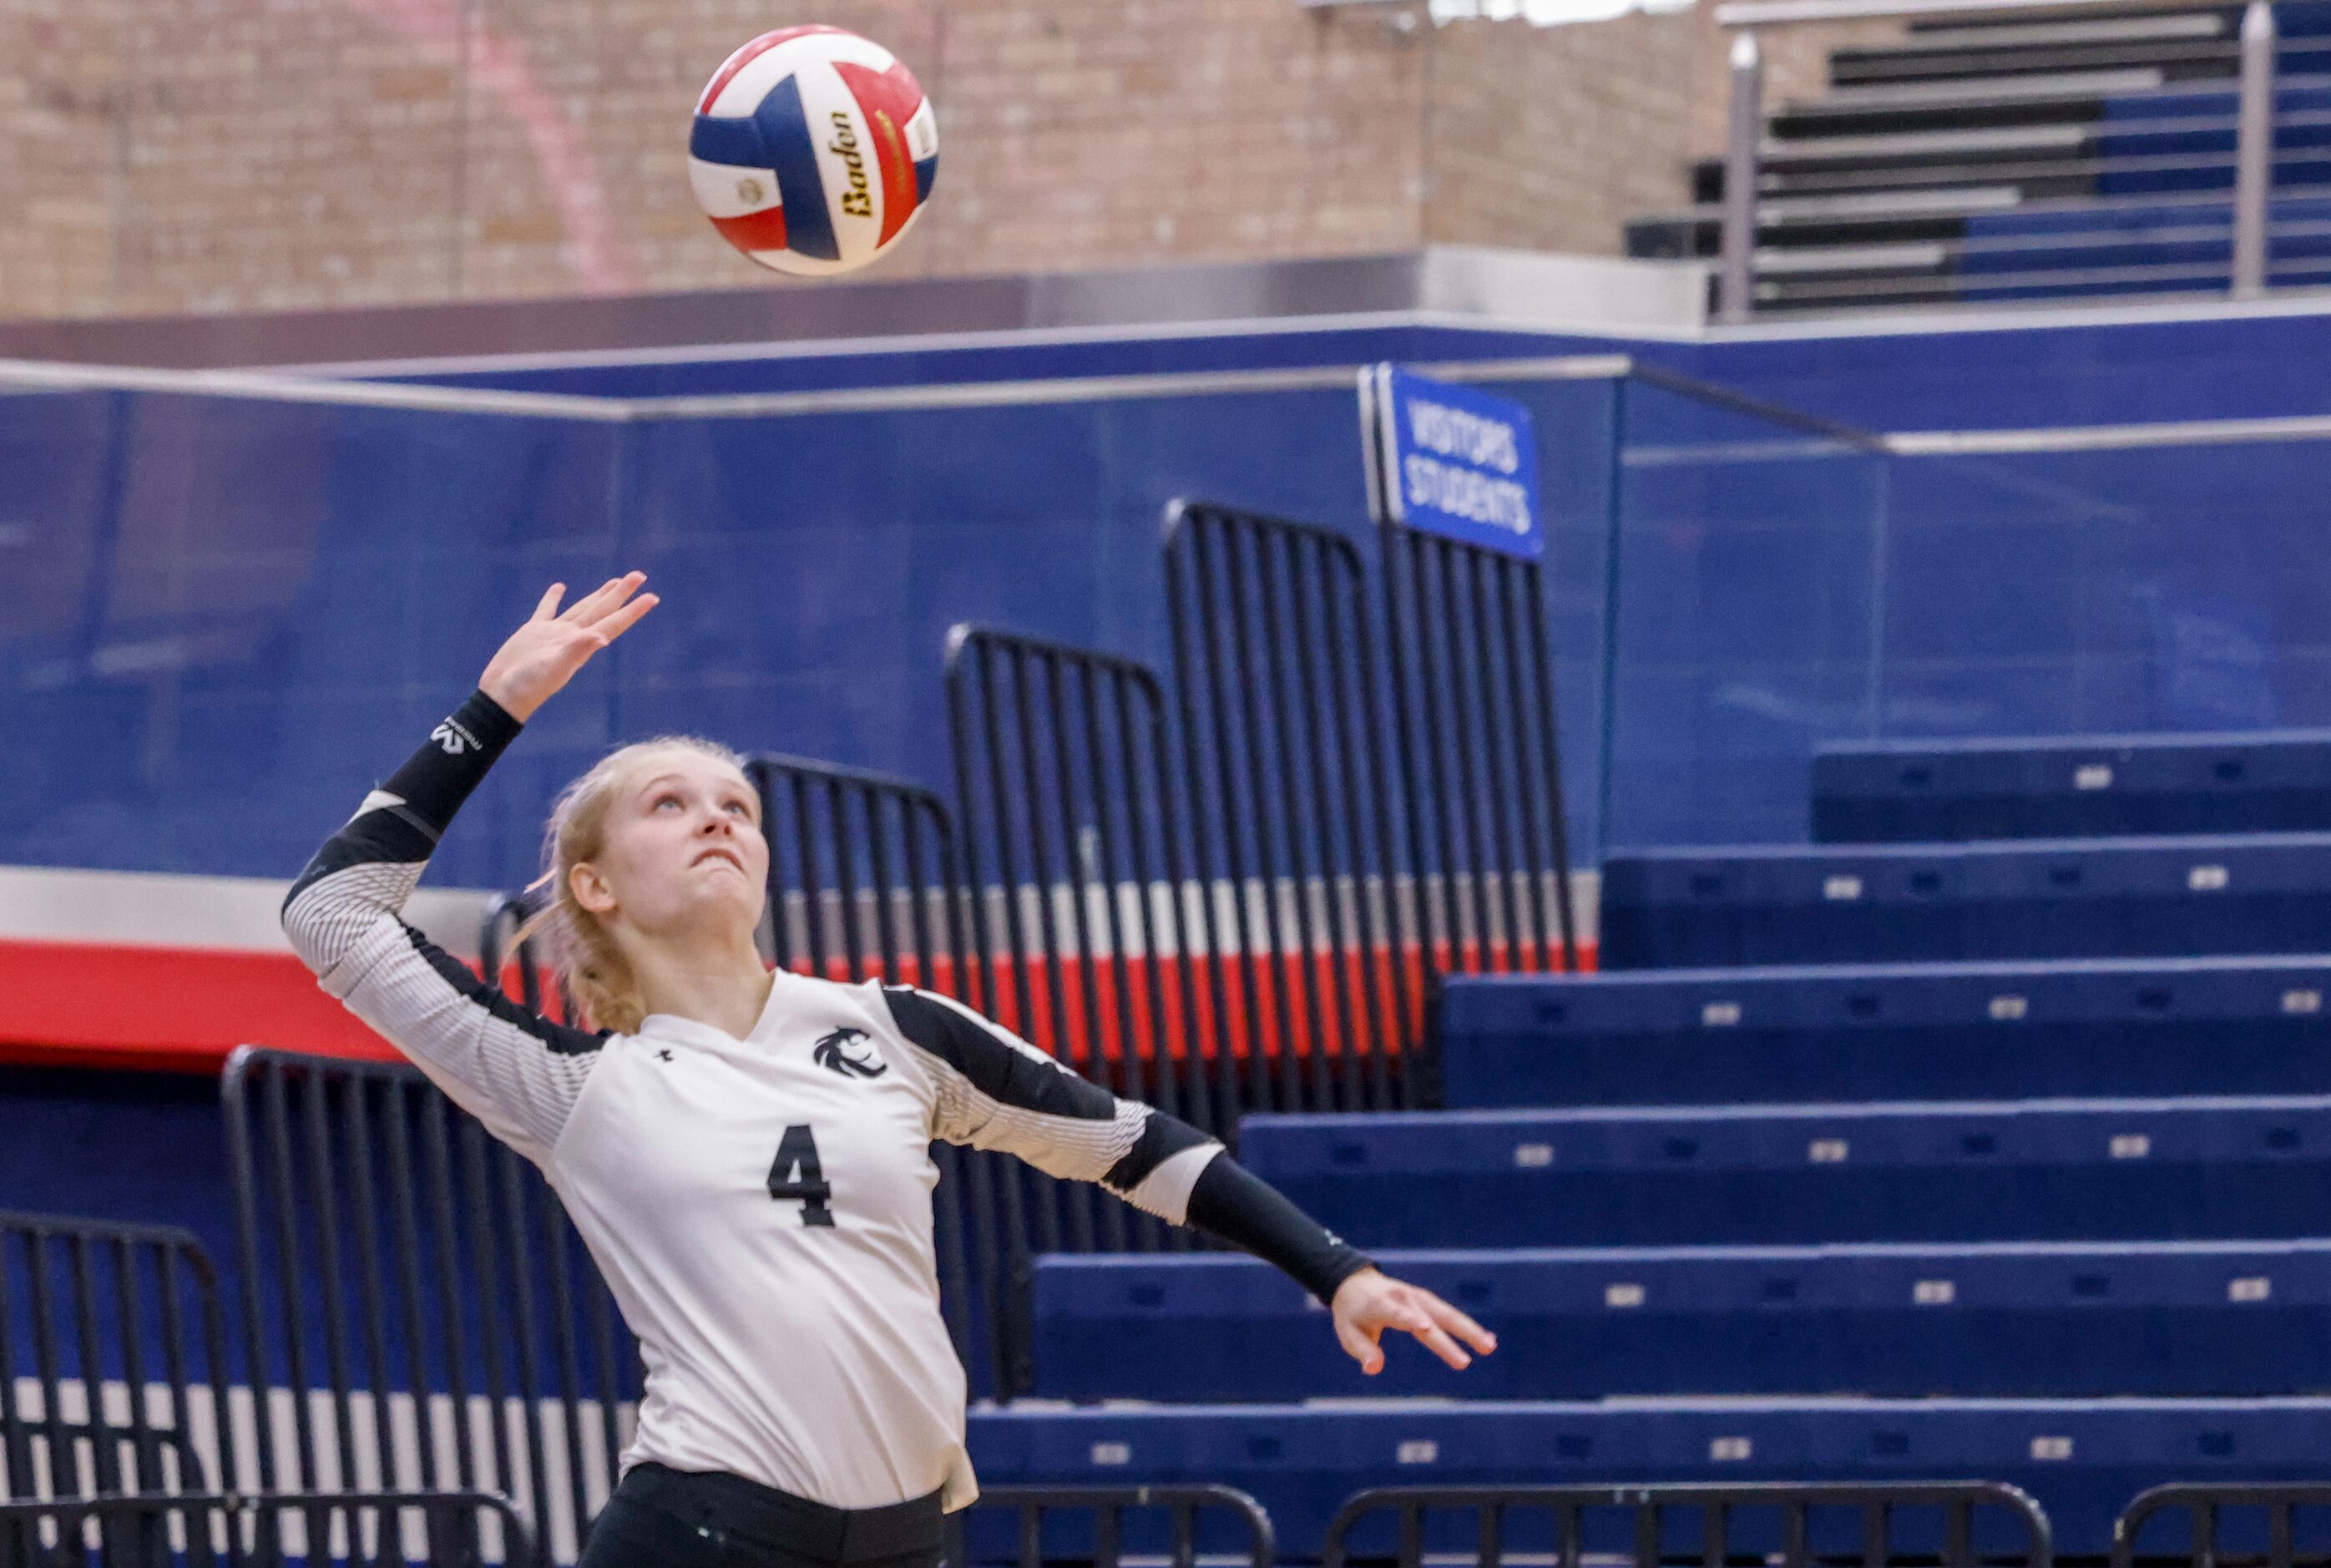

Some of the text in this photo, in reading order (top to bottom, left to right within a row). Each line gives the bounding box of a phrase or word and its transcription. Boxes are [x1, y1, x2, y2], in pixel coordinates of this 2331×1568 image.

[827, 111, 873, 218] Baden
[1407, 398, 1519, 473] VISITORS
[1406, 454, 1531, 535] STUDENTS
[767, 1124, 835, 1227] 4
